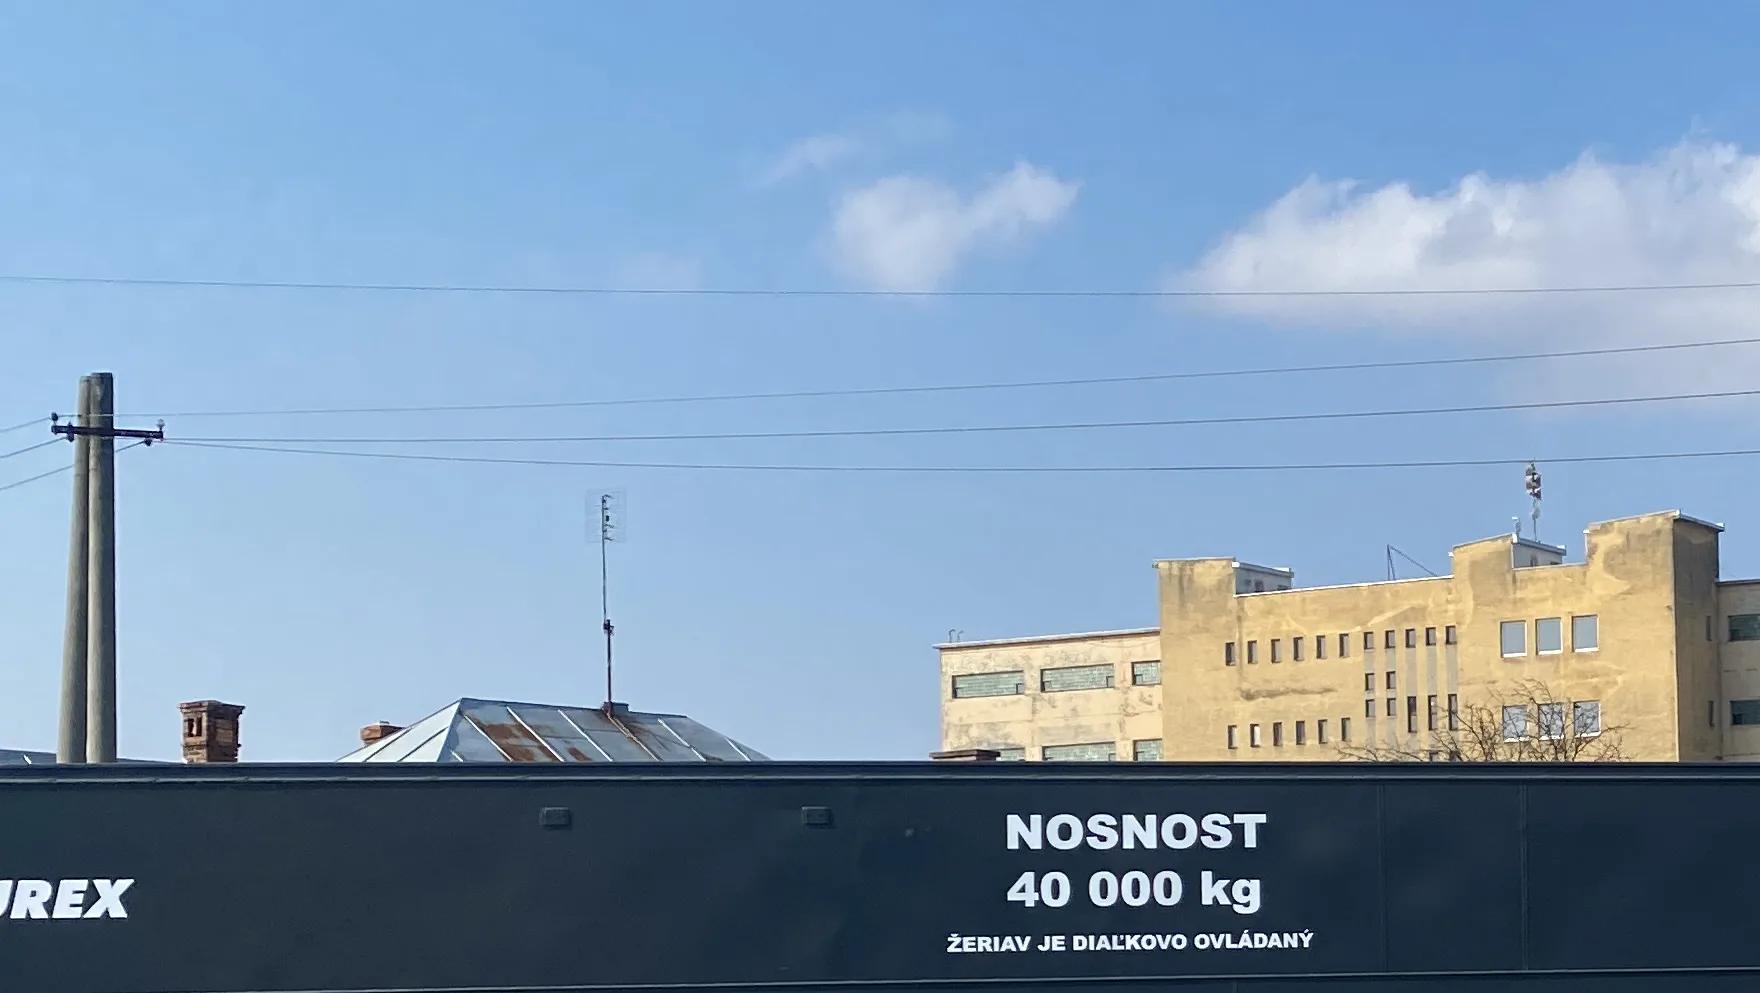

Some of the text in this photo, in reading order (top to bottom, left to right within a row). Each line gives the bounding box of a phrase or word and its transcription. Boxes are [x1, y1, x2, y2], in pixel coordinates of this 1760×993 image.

[1006, 813, 1267, 850] NOSNOST
[1006, 870, 1261, 914] 40 000 kg
[946, 928, 1314, 953] ŽERIAV JE DIAĽKOVO OVLÁDANÝ
